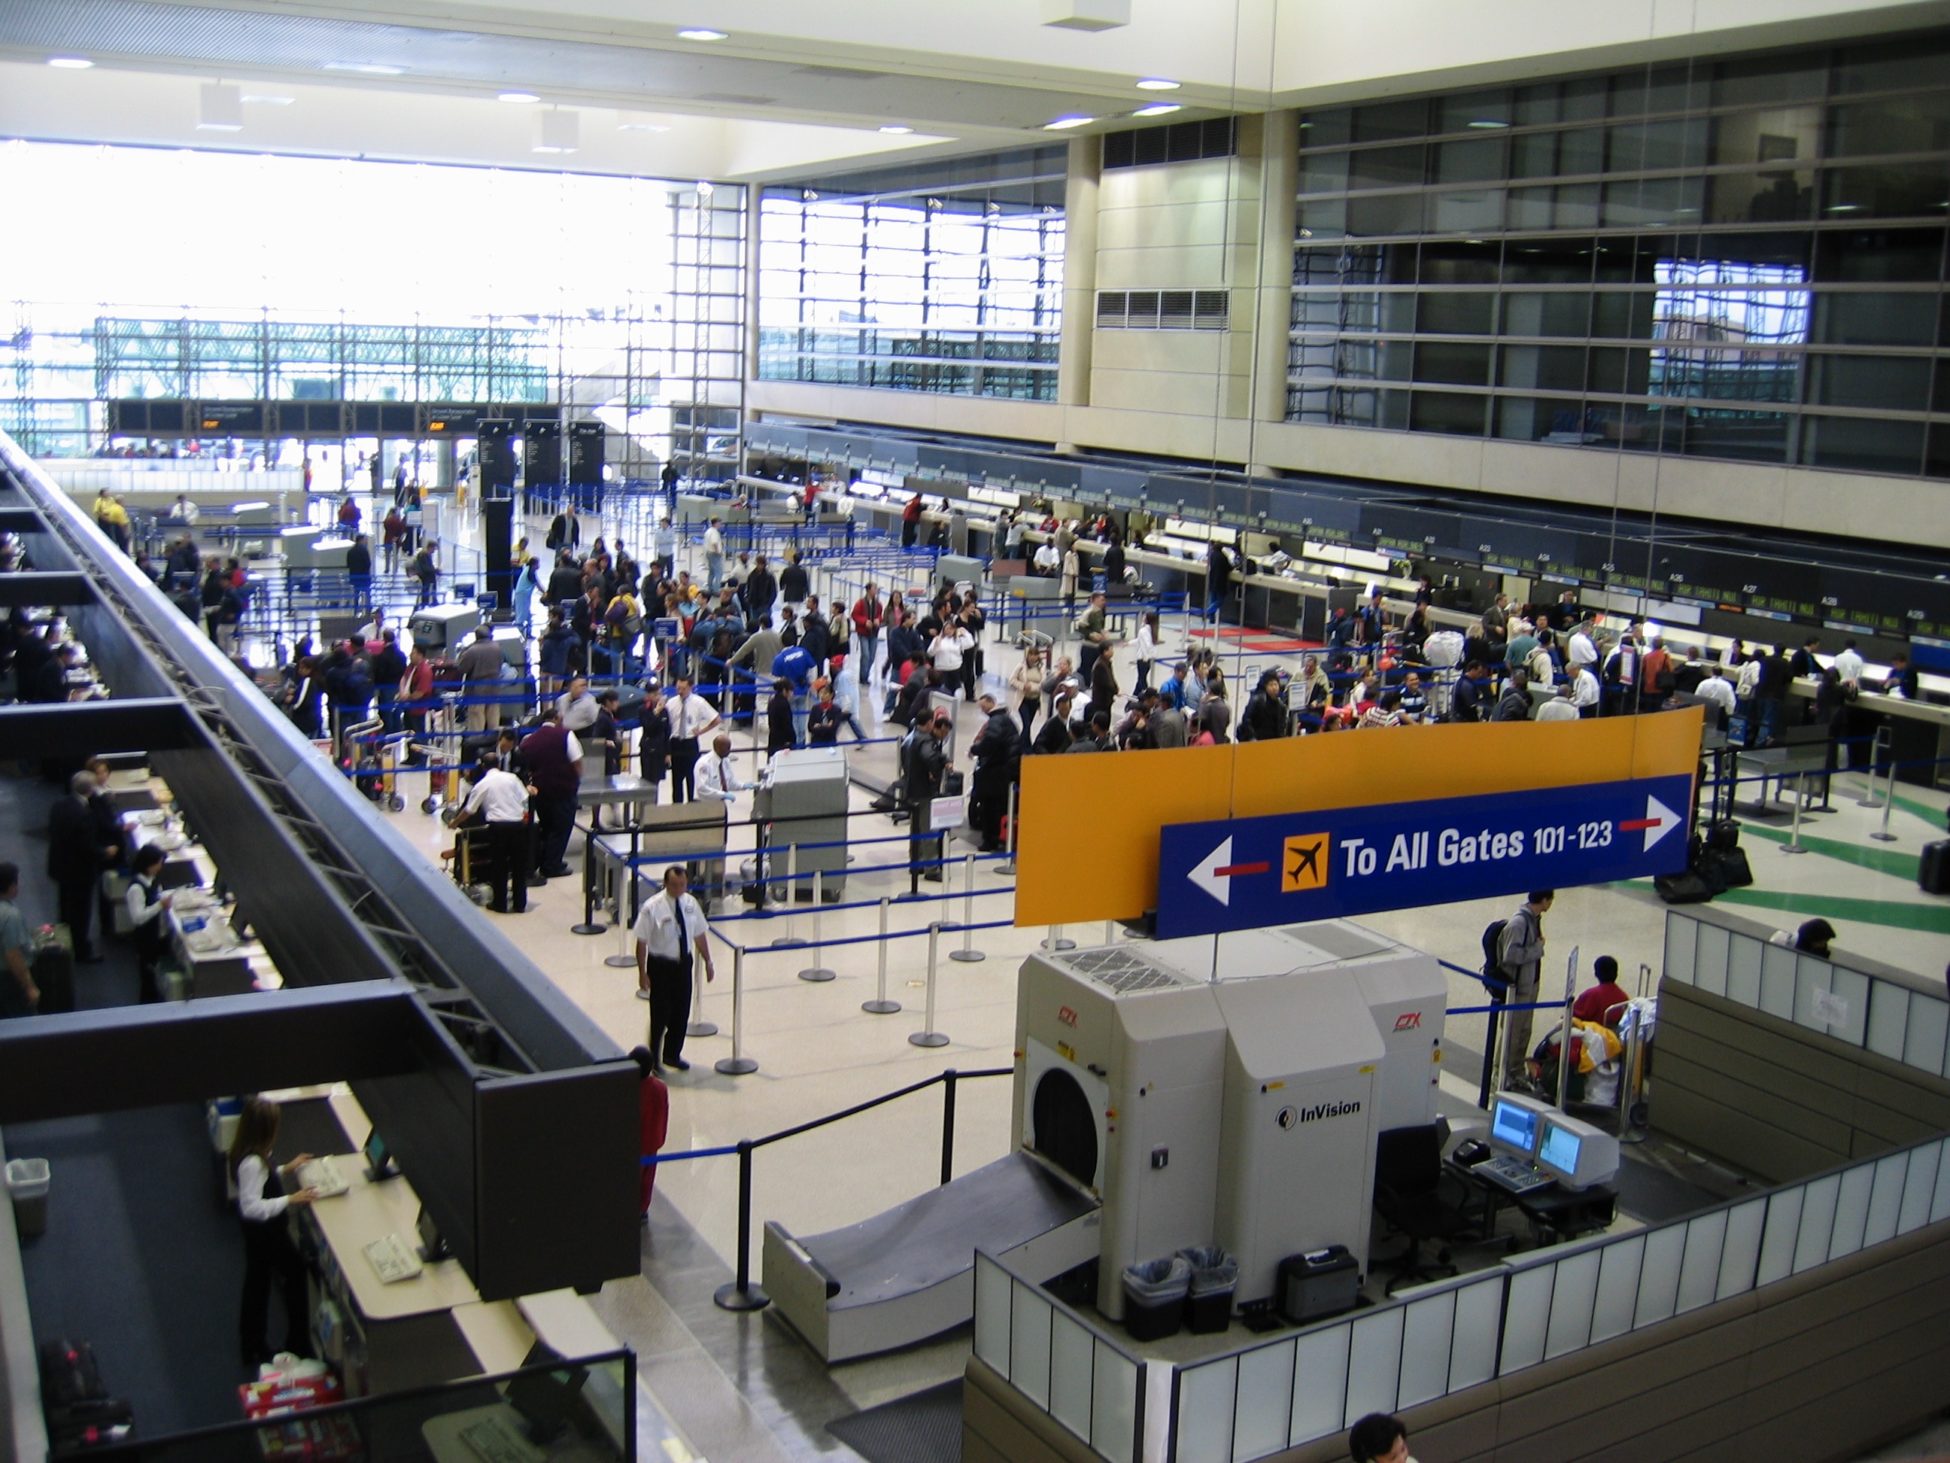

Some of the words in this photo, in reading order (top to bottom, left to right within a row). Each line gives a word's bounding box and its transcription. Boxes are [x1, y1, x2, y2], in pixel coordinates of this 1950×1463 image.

[1742, 584, 1758, 594] A27
[1821, 595, 1838, 607] A28
[1906, 609, 1926, 620] A29
[1340, 838, 1377, 878] To
[1385, 831, 1429, 873] All
[1437, 827, 1524, 867] Gates
[1533, 820, 1613, 855] 101-123
[1394, 1011, 1422, 1028] CTX
[1300, 1101, 1361, 1123] InVision
